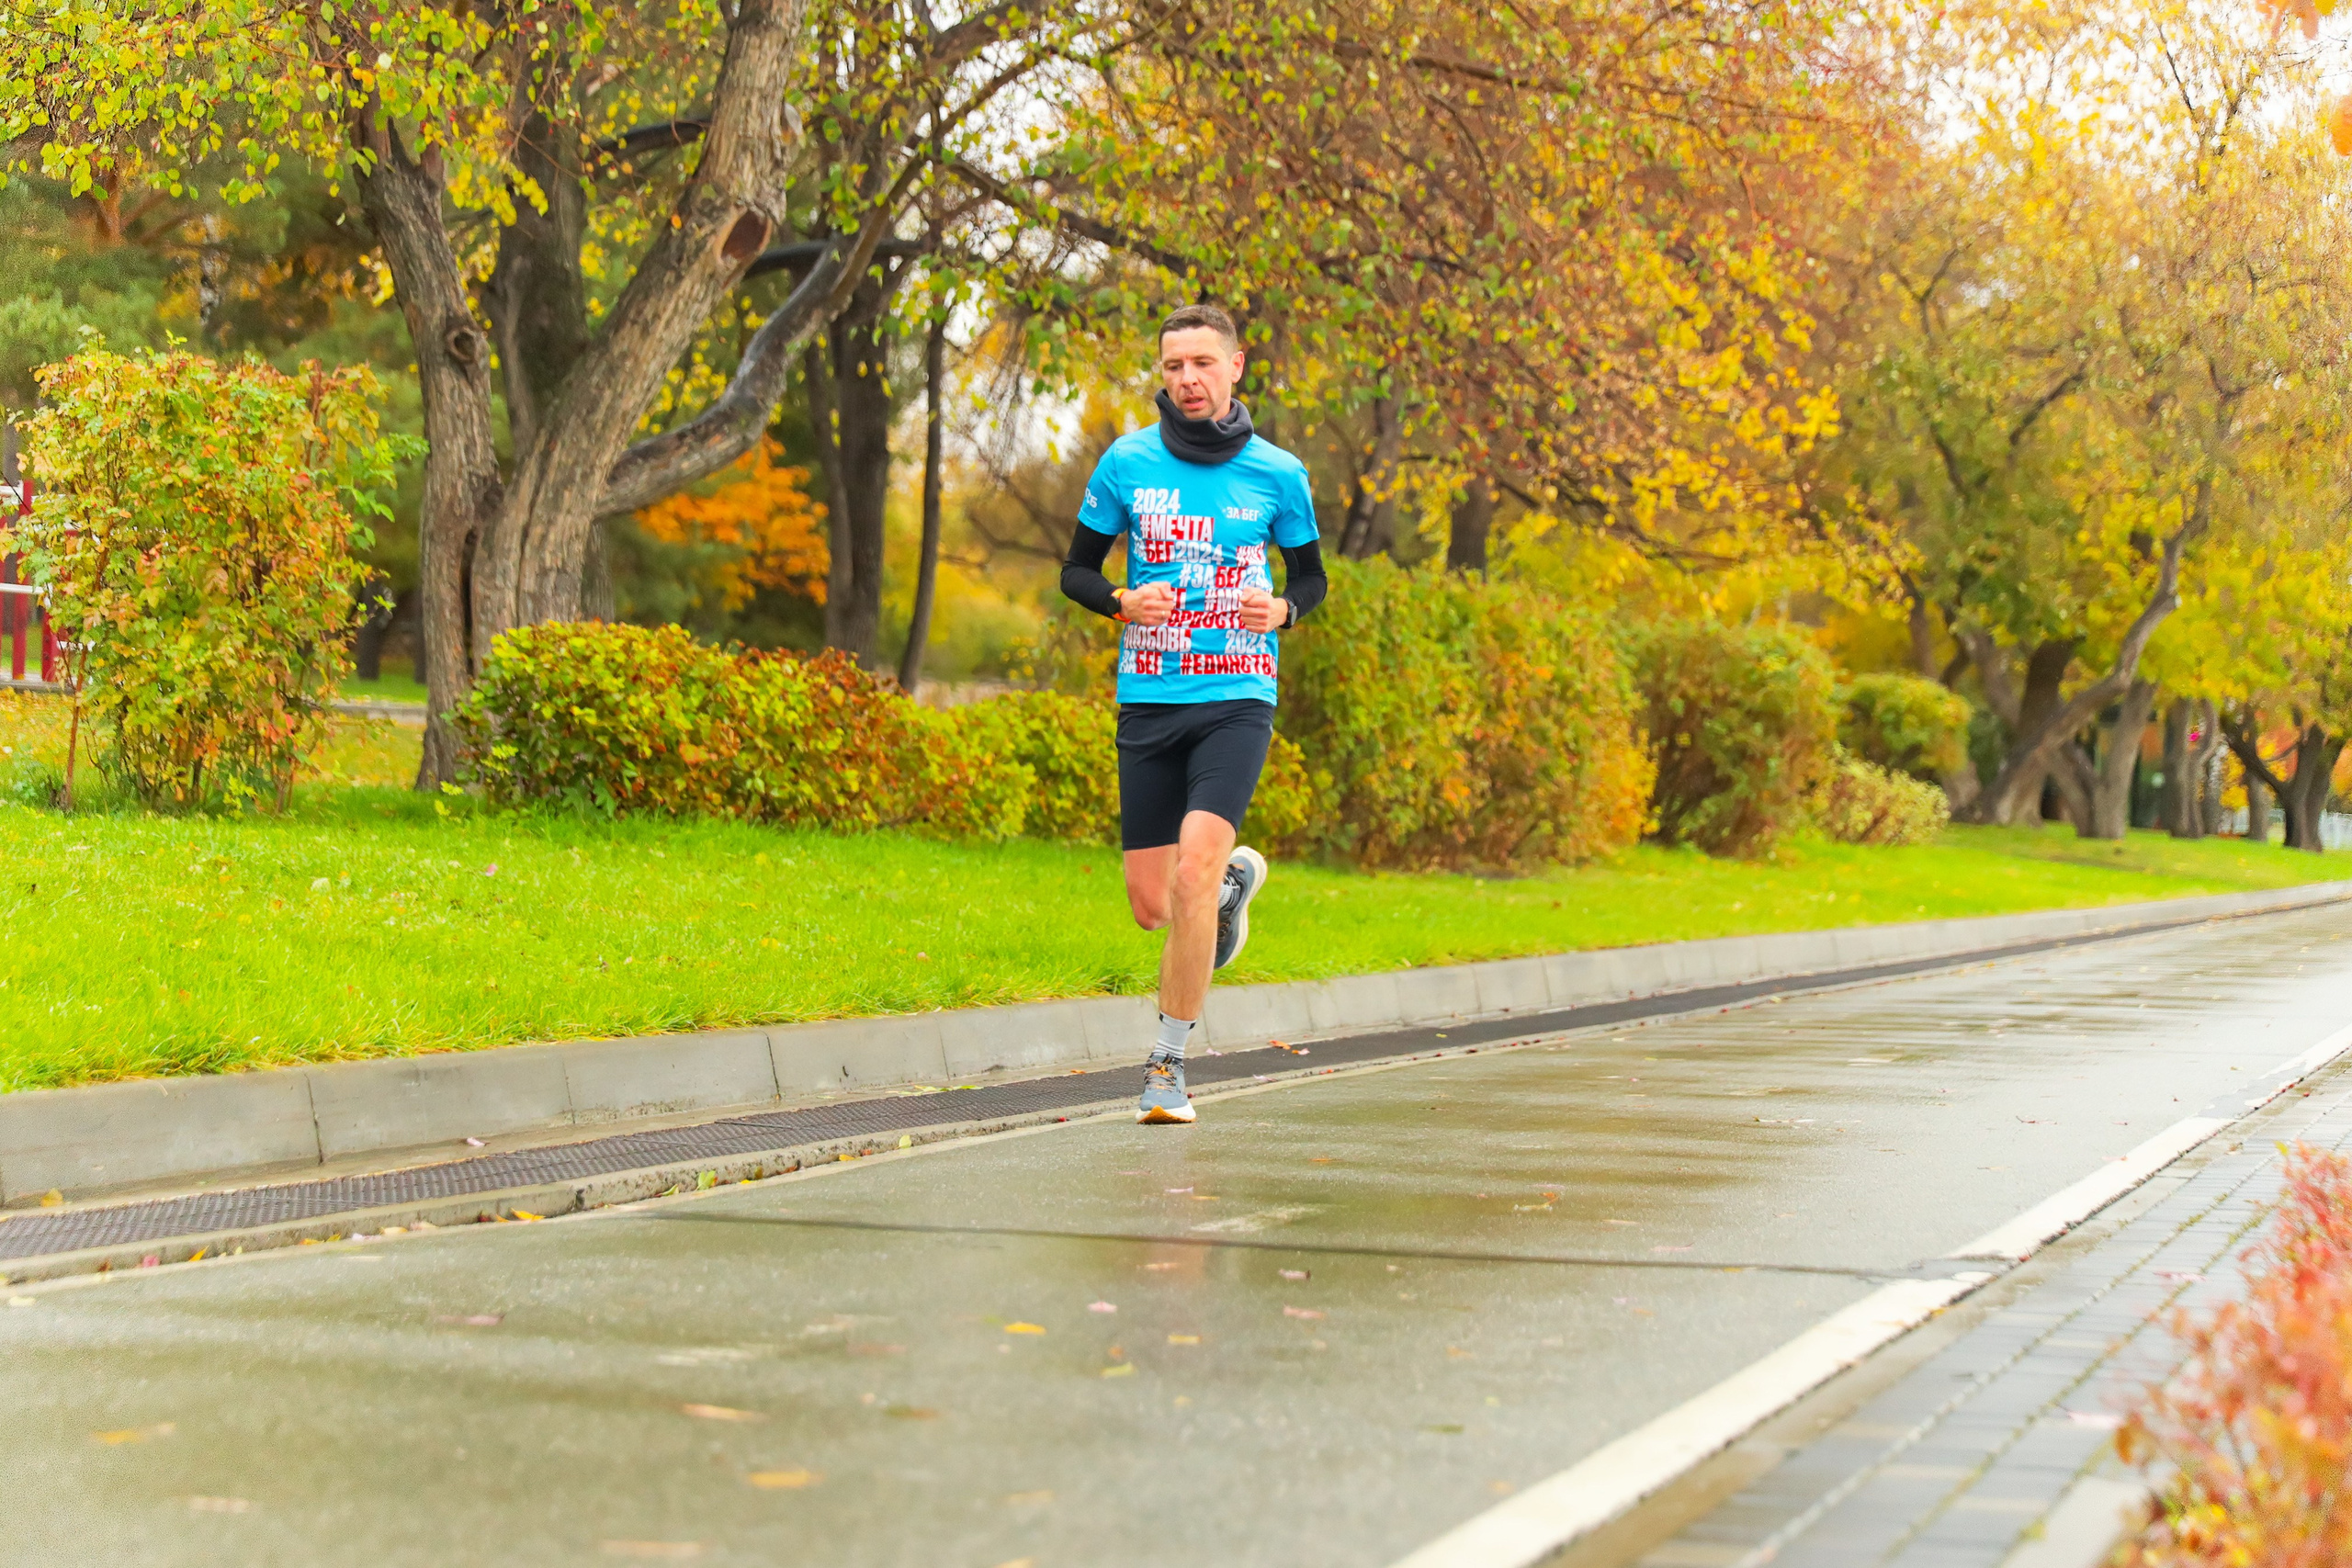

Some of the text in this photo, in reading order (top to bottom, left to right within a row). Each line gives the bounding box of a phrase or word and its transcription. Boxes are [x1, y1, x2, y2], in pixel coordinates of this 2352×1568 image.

[1133, 488, 1181, 513] 2024
[1139, 514, 1214, 541] #МЕЧТА
[1225, 629, 1267, 653] 2024
